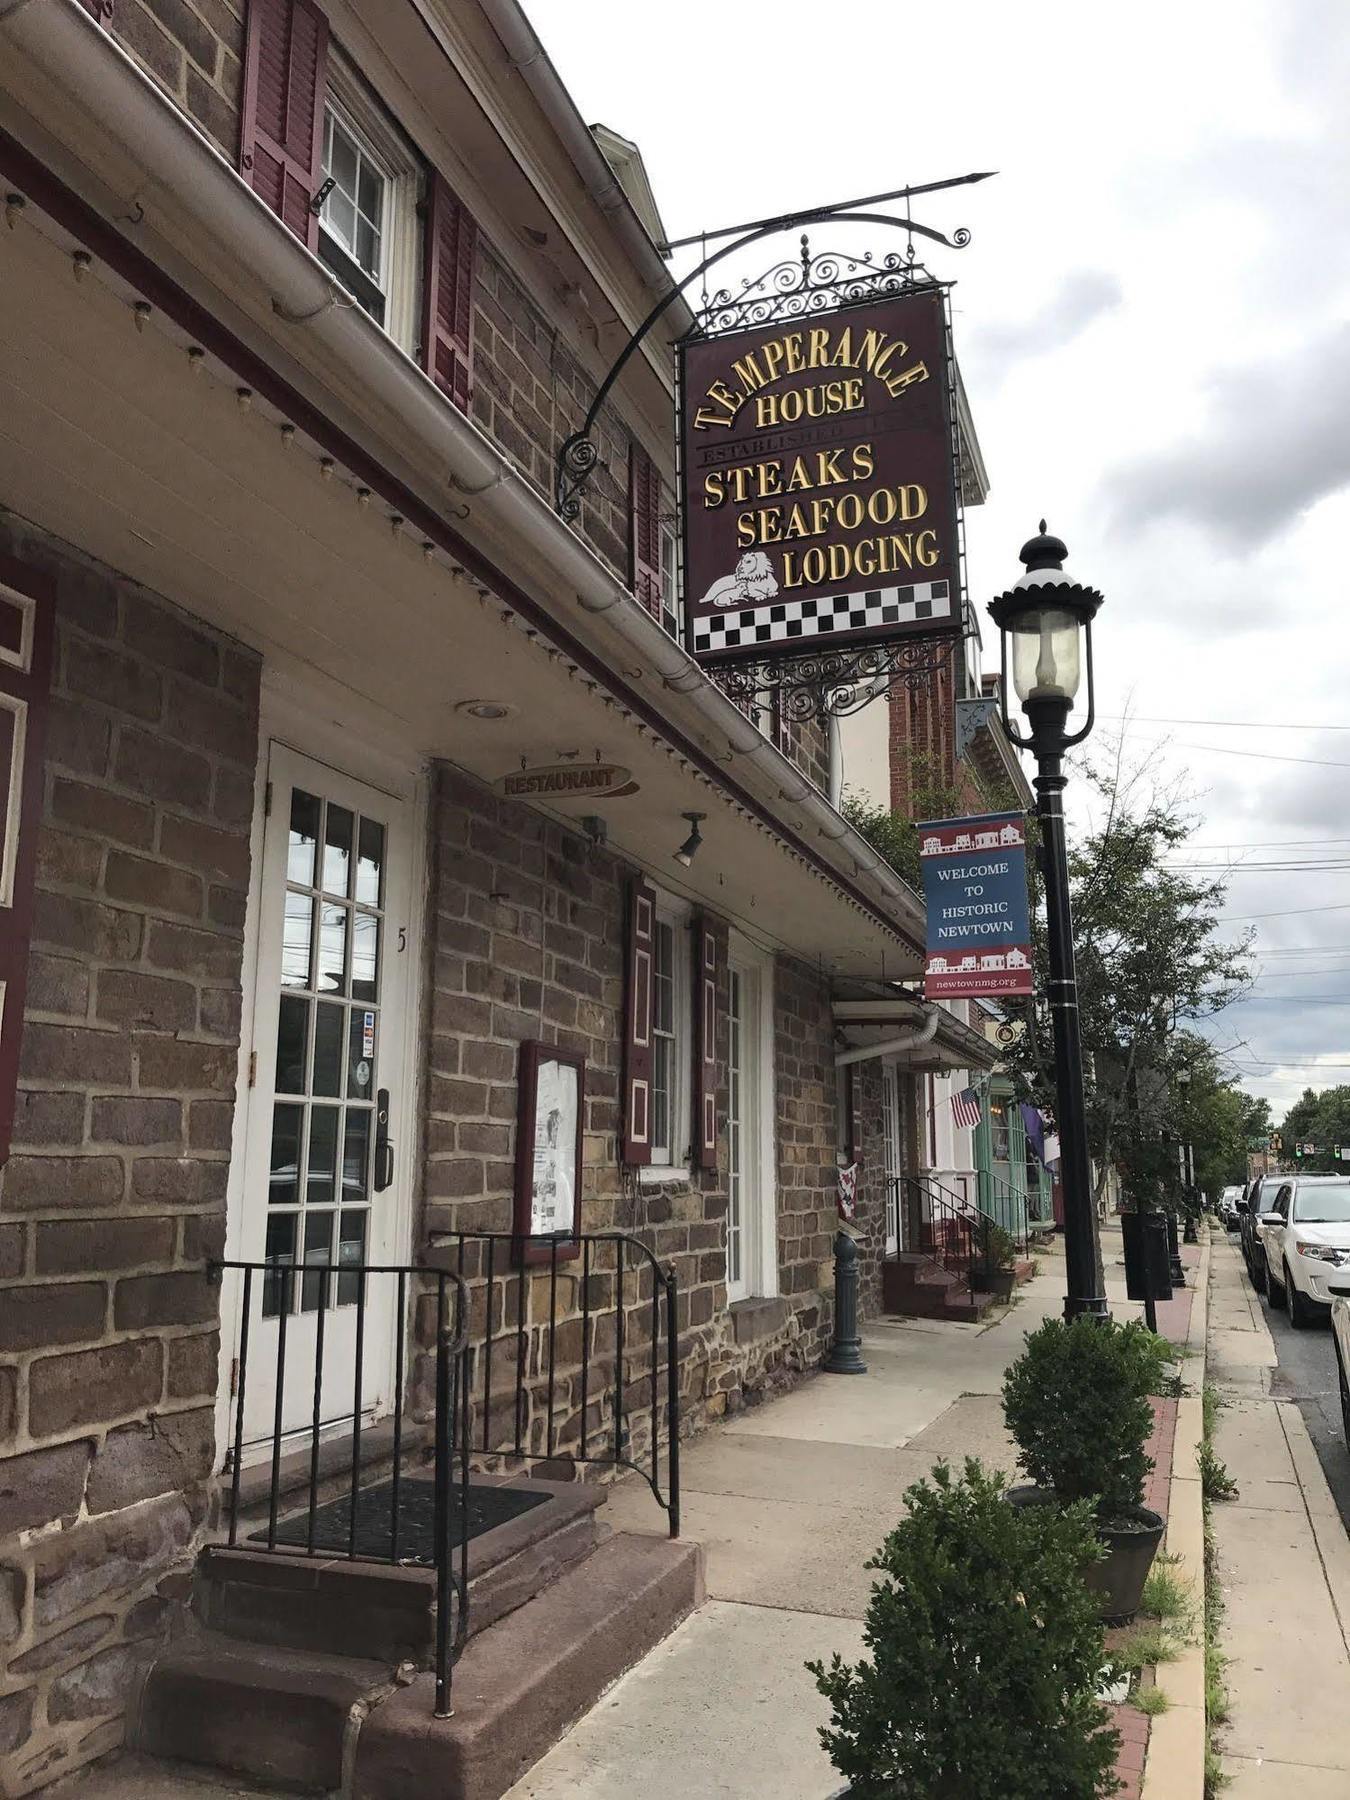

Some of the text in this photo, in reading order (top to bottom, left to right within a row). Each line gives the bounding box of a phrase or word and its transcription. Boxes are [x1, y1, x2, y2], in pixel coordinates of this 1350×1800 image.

[693, 327, 930, 431] TEMPERANCE
[755, 378, 865, 428] HOUSE
[704, 444, 875, 508] STEAKS
[737, 484, 928, 548] SEAFOOD
[783, 529, 941, 588] LODGING
[504, 768, 616, 795] RESTAURANT
[937, 863, 1009, 881] WELCOME
[964, 885, 984, 897] TO
[942, 902, 1008, 919] HISTORIC
[397, 927, 407, 953] 5
[937, 921, 1014, 938] NEWTOWN
[936, 977, 1017, 989] newtownmg.org
